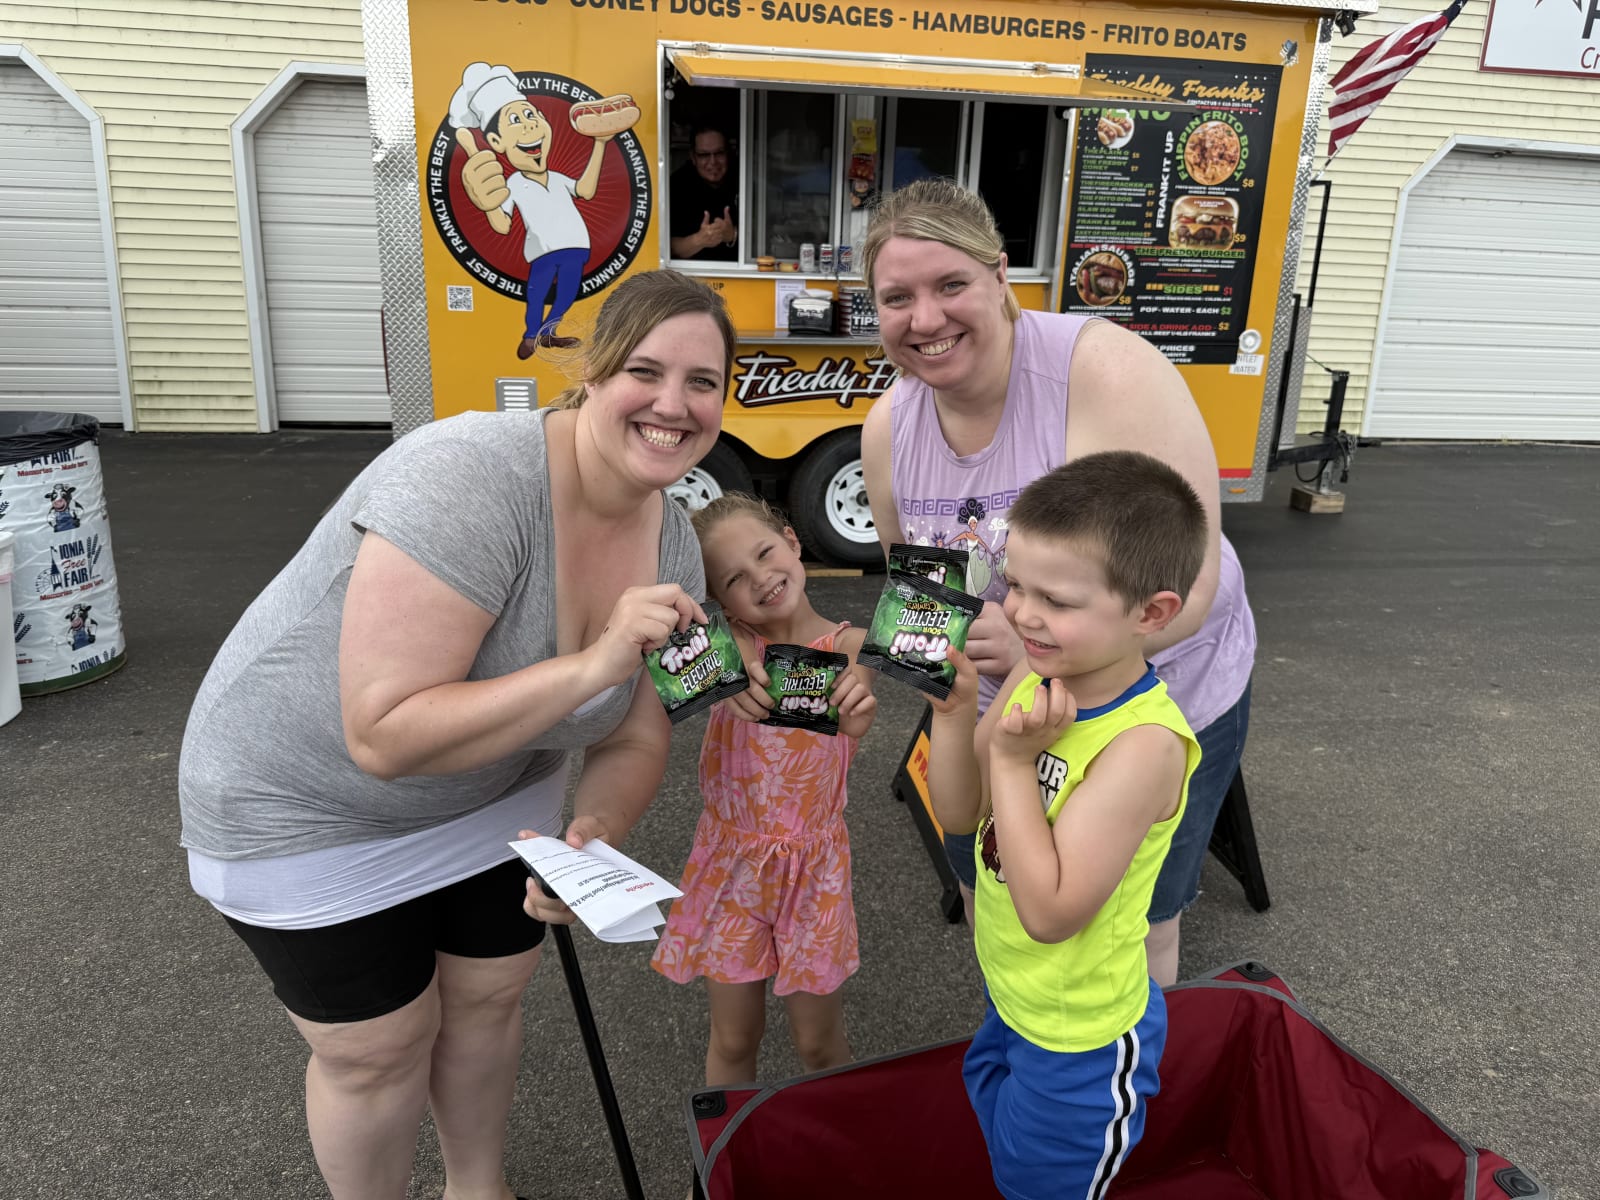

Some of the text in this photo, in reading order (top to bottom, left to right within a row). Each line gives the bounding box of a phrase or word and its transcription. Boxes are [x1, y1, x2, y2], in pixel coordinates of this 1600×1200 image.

[670, 0, 741, 18] DOGS
[761, 0, 893, 28] SAUSAGES
[912, 10, 1086, 41] HAMBURGERS
[1103, 23, 1169, 46] FRITO
[1174, 28, 1247, 51] BOATS
[543, 78, 568, 94] THE
[571, 86, 597, 102] BES
[1182, 79, 1265, 102] Franks
[1175, 110, 1249, 181] FLIPPIN FRITO BOAT
[1155, 130, 1175, 229] FRANK IT UP
[432, 131, 467, 254] FRANKLY THE BEST
[619, 131, 648, 252] FRANKLY THE BEST
[1234, 233, 1247, 243] $9
[1135, 247, 1246, 259] THE FREDDY BURGER
[465, 252, 627, 296] FRANKLY THE BEST
[1069, 244, 1136, 287] ITALIAN SAUSAGE
[712, 282, 725, 290] UP
[1163, 285, 1233, 296] SIDES $1
[852, 316, 880, 326] TIPS
[1220, 306, 1232, 315] $2
[1218, 322, 1230, 331] $2
[736, 353, 859, 405] Freddy
[59, 540, 85, 560] IONIA
[61, 558, 86, 573] Free
[63, 567, 89, 588] FAIR
[896, 608, 952, 629] ELECTRIC
[922, 627, 942, 635] SOUR
[660, 626, 710, 674] Trolli
[889, 632, 949, 662] Trolli
[680, 662, 697, 675] SOUR
[680, 650, 722, 695] ELECTRIC
[780, 672, 827, 692] ELECTRIC
[780, 695, 829, 715] Trolli
